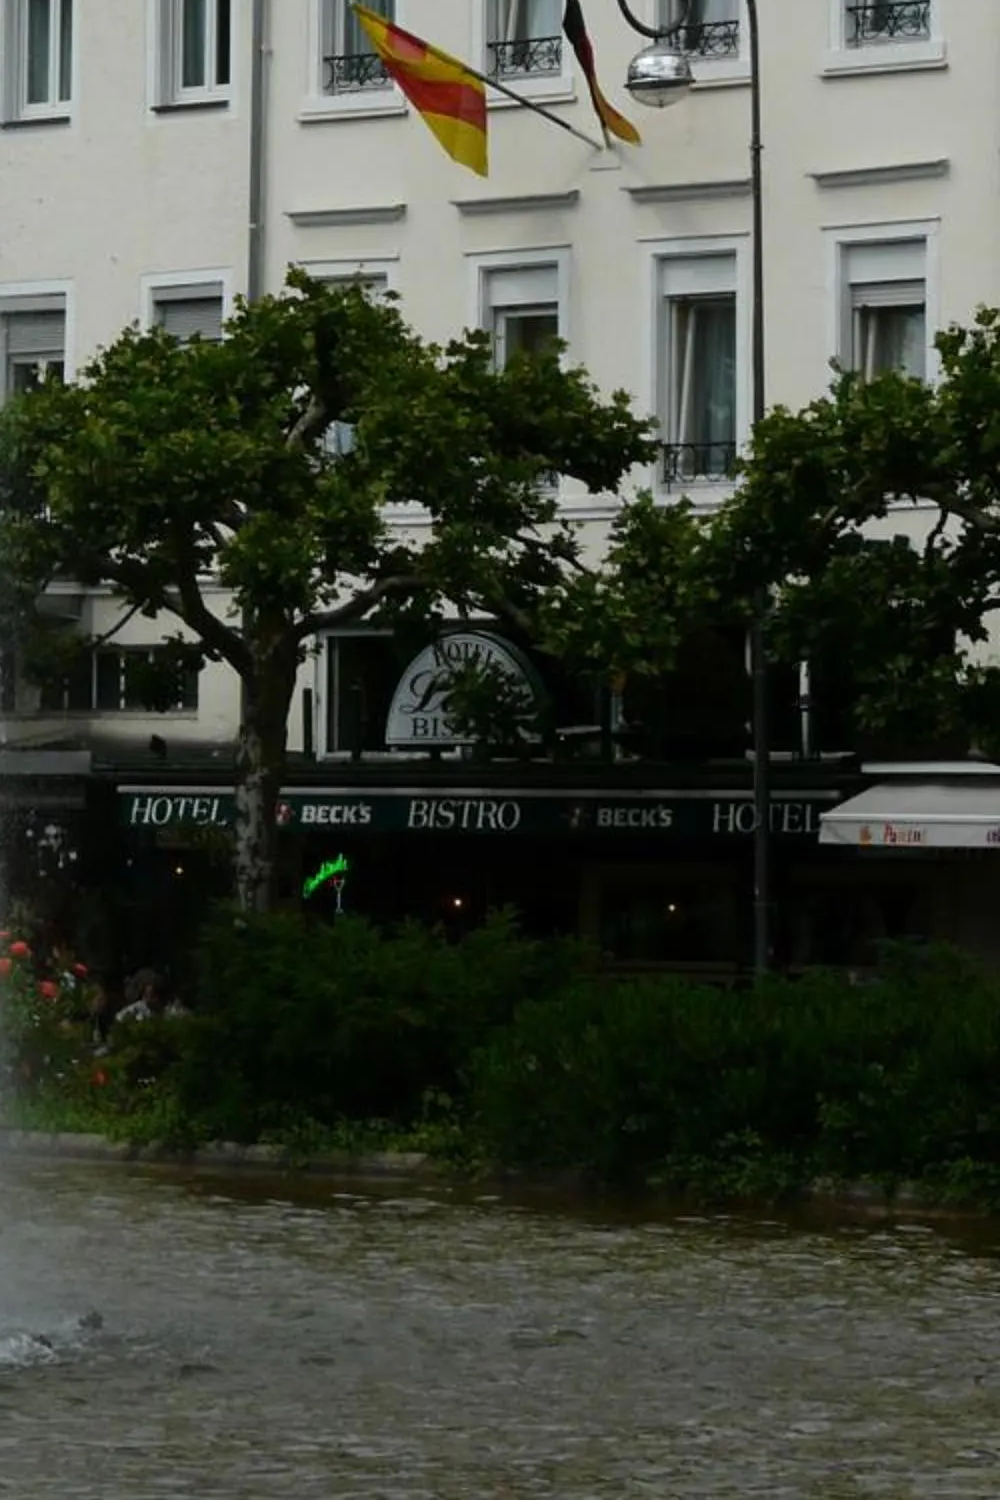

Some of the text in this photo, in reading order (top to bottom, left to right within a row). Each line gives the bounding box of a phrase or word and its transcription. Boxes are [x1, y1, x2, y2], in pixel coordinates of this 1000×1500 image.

[130, 796, 228, 825] HOTEL
[301, 800, 373, 824] BECK'S
[407, 799, 521, 830] BISTRO
[597, 803, 674, 828] BECK'S
